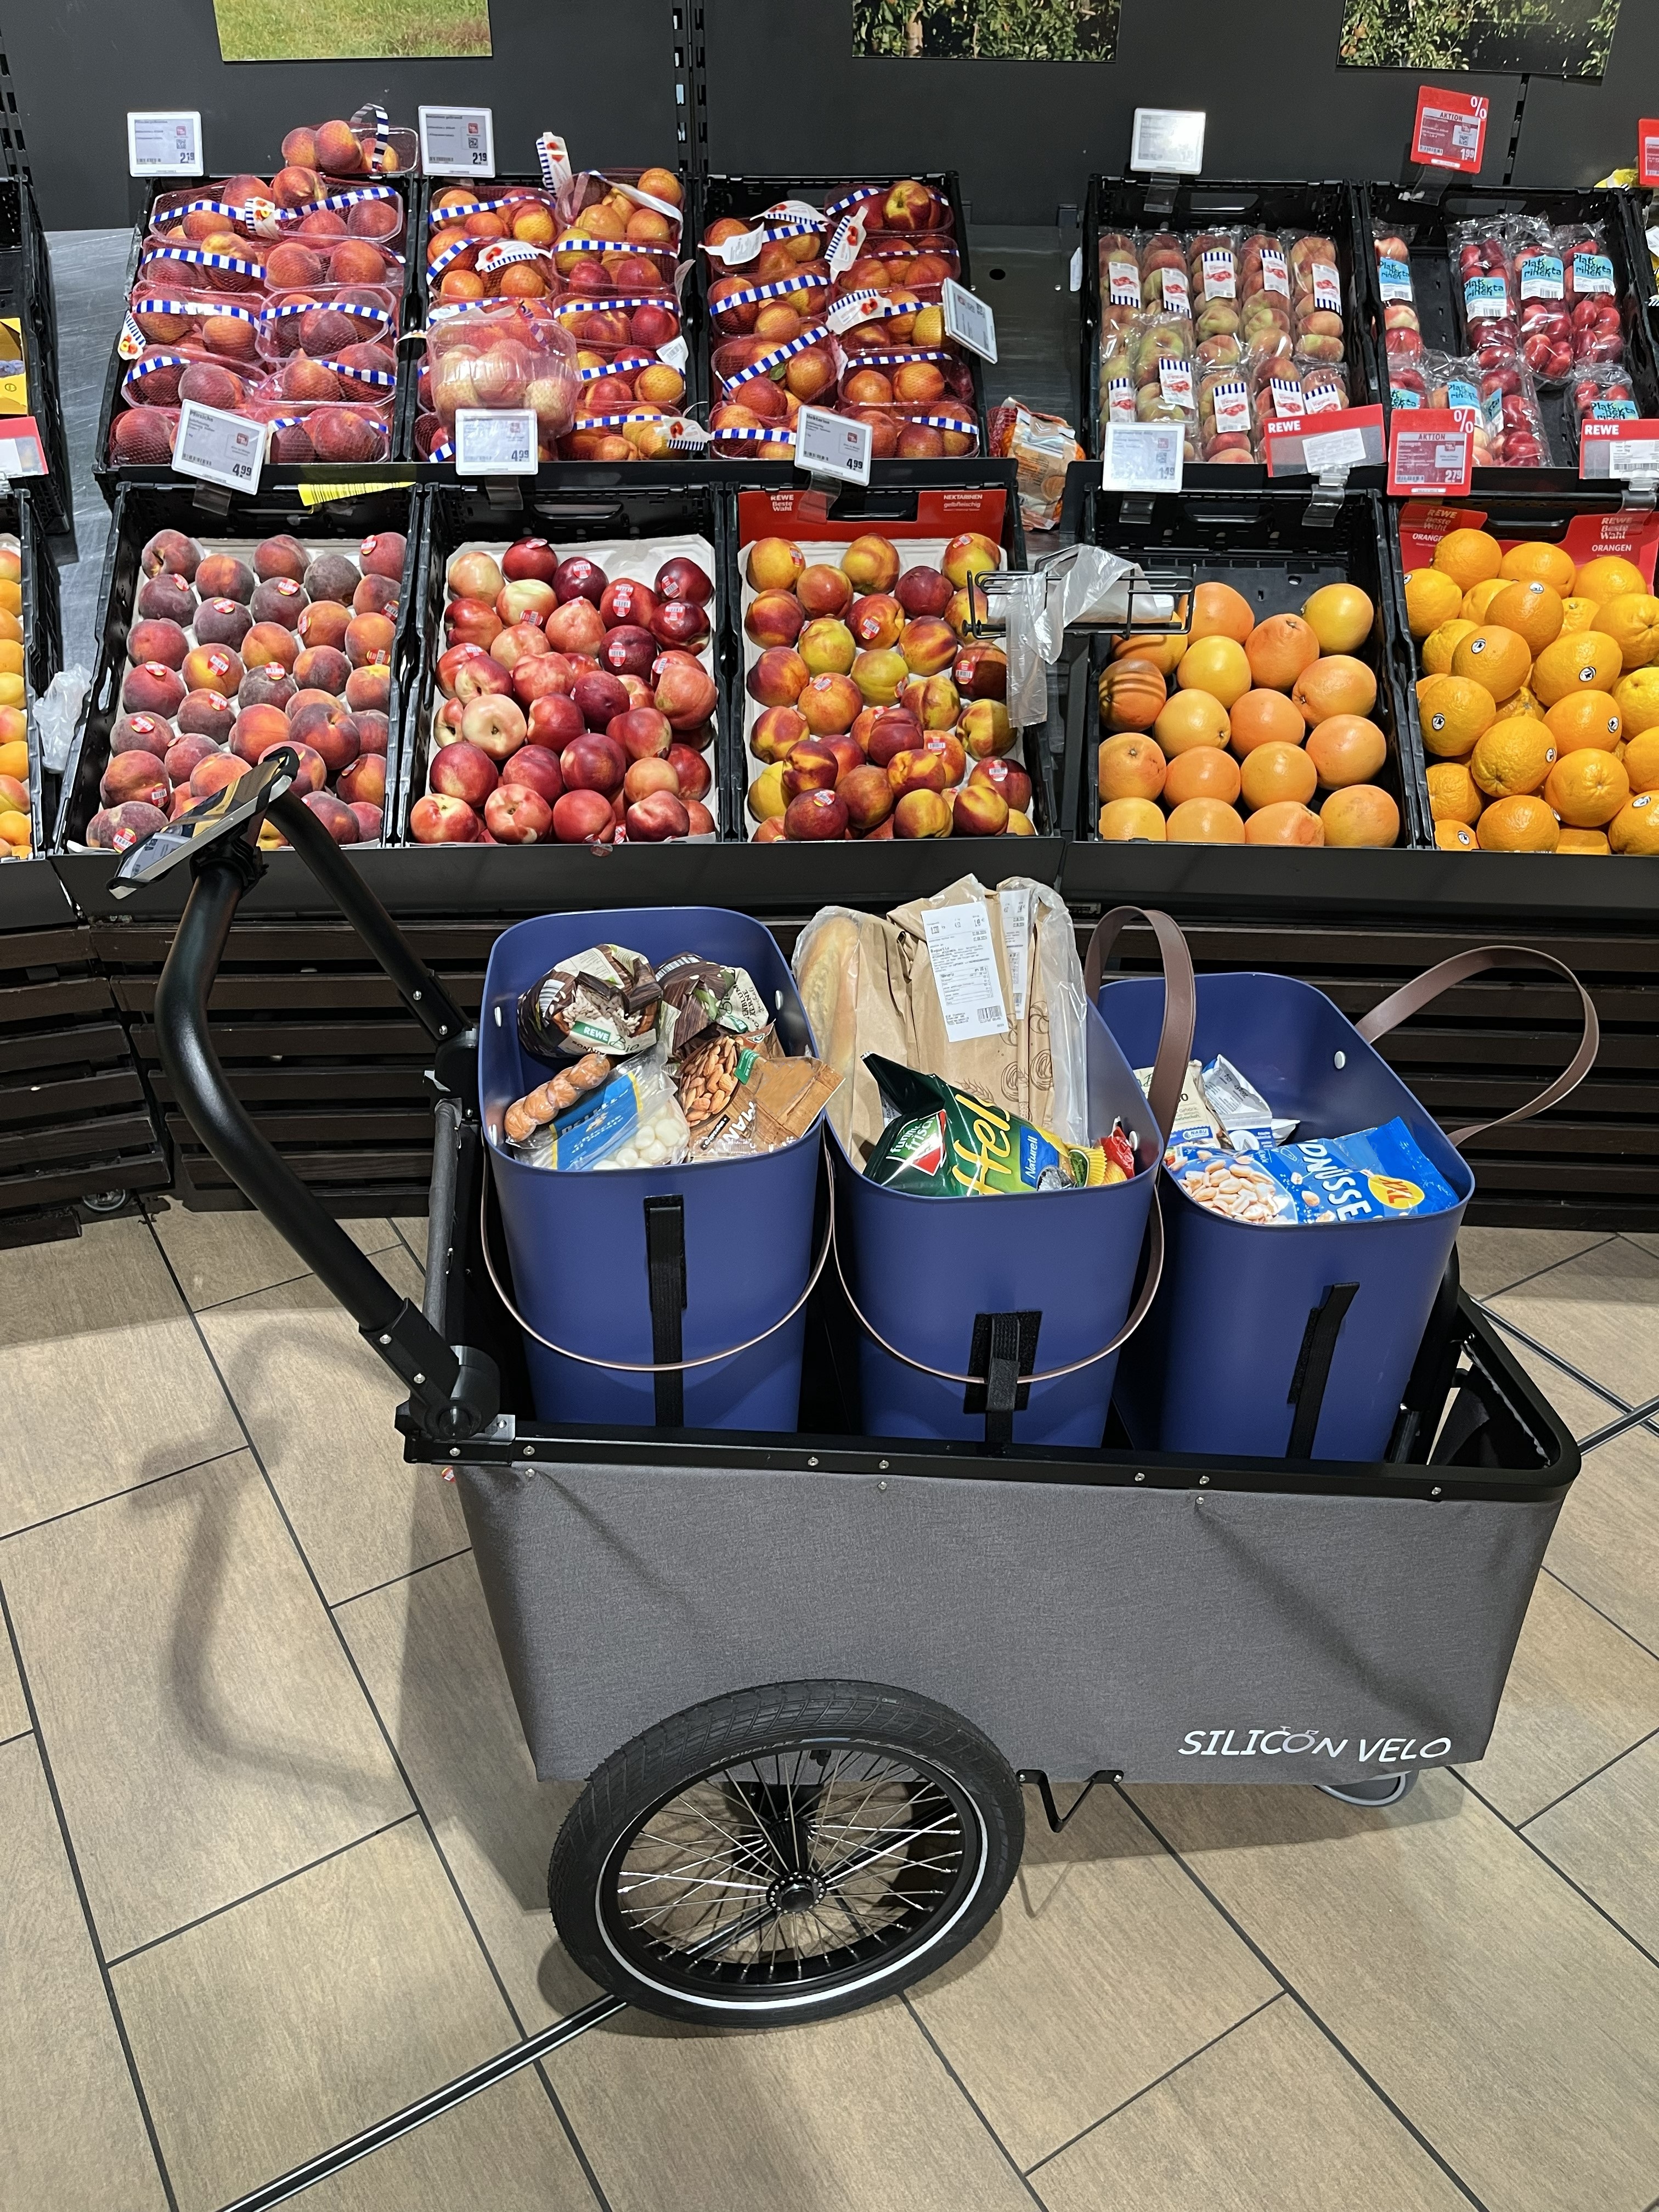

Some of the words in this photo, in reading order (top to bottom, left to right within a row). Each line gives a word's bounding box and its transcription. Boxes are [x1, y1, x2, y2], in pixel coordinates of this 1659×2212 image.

[1440, 112, 1463, 121] AKTION
[472, 152, 487, 165] 2.19
[1267, 420, 1301, 433] REWE
[1584, 424, 1620, 435] REWE
[511, 450, 529, 461] 4.99
[847, 459, 863, 470] 4.99
[233, 463, 252, 478] 4.99
[1427, 509, 1458, 518] REWE
[1426, 517, 1451, 525] Beste
[1424, 522, 1447, 532] Wahl
[1600, 531, 1626, 539] Wahl
[1592, 544, 1632, 552] ORANGEN
[742, 989, 756, 1016] KERNE
[583, 1026, 610, 1041] REWE
[609, 1035, 639, 1053] Bio
[1024, 1135, 1039, 1180] Naturell
[1296, 1143, 1372, 1221] DNÜSSE
[1178, 1728, 1348, 1758] SILICON
[1358, 1737, 1452, 1762] VELO
